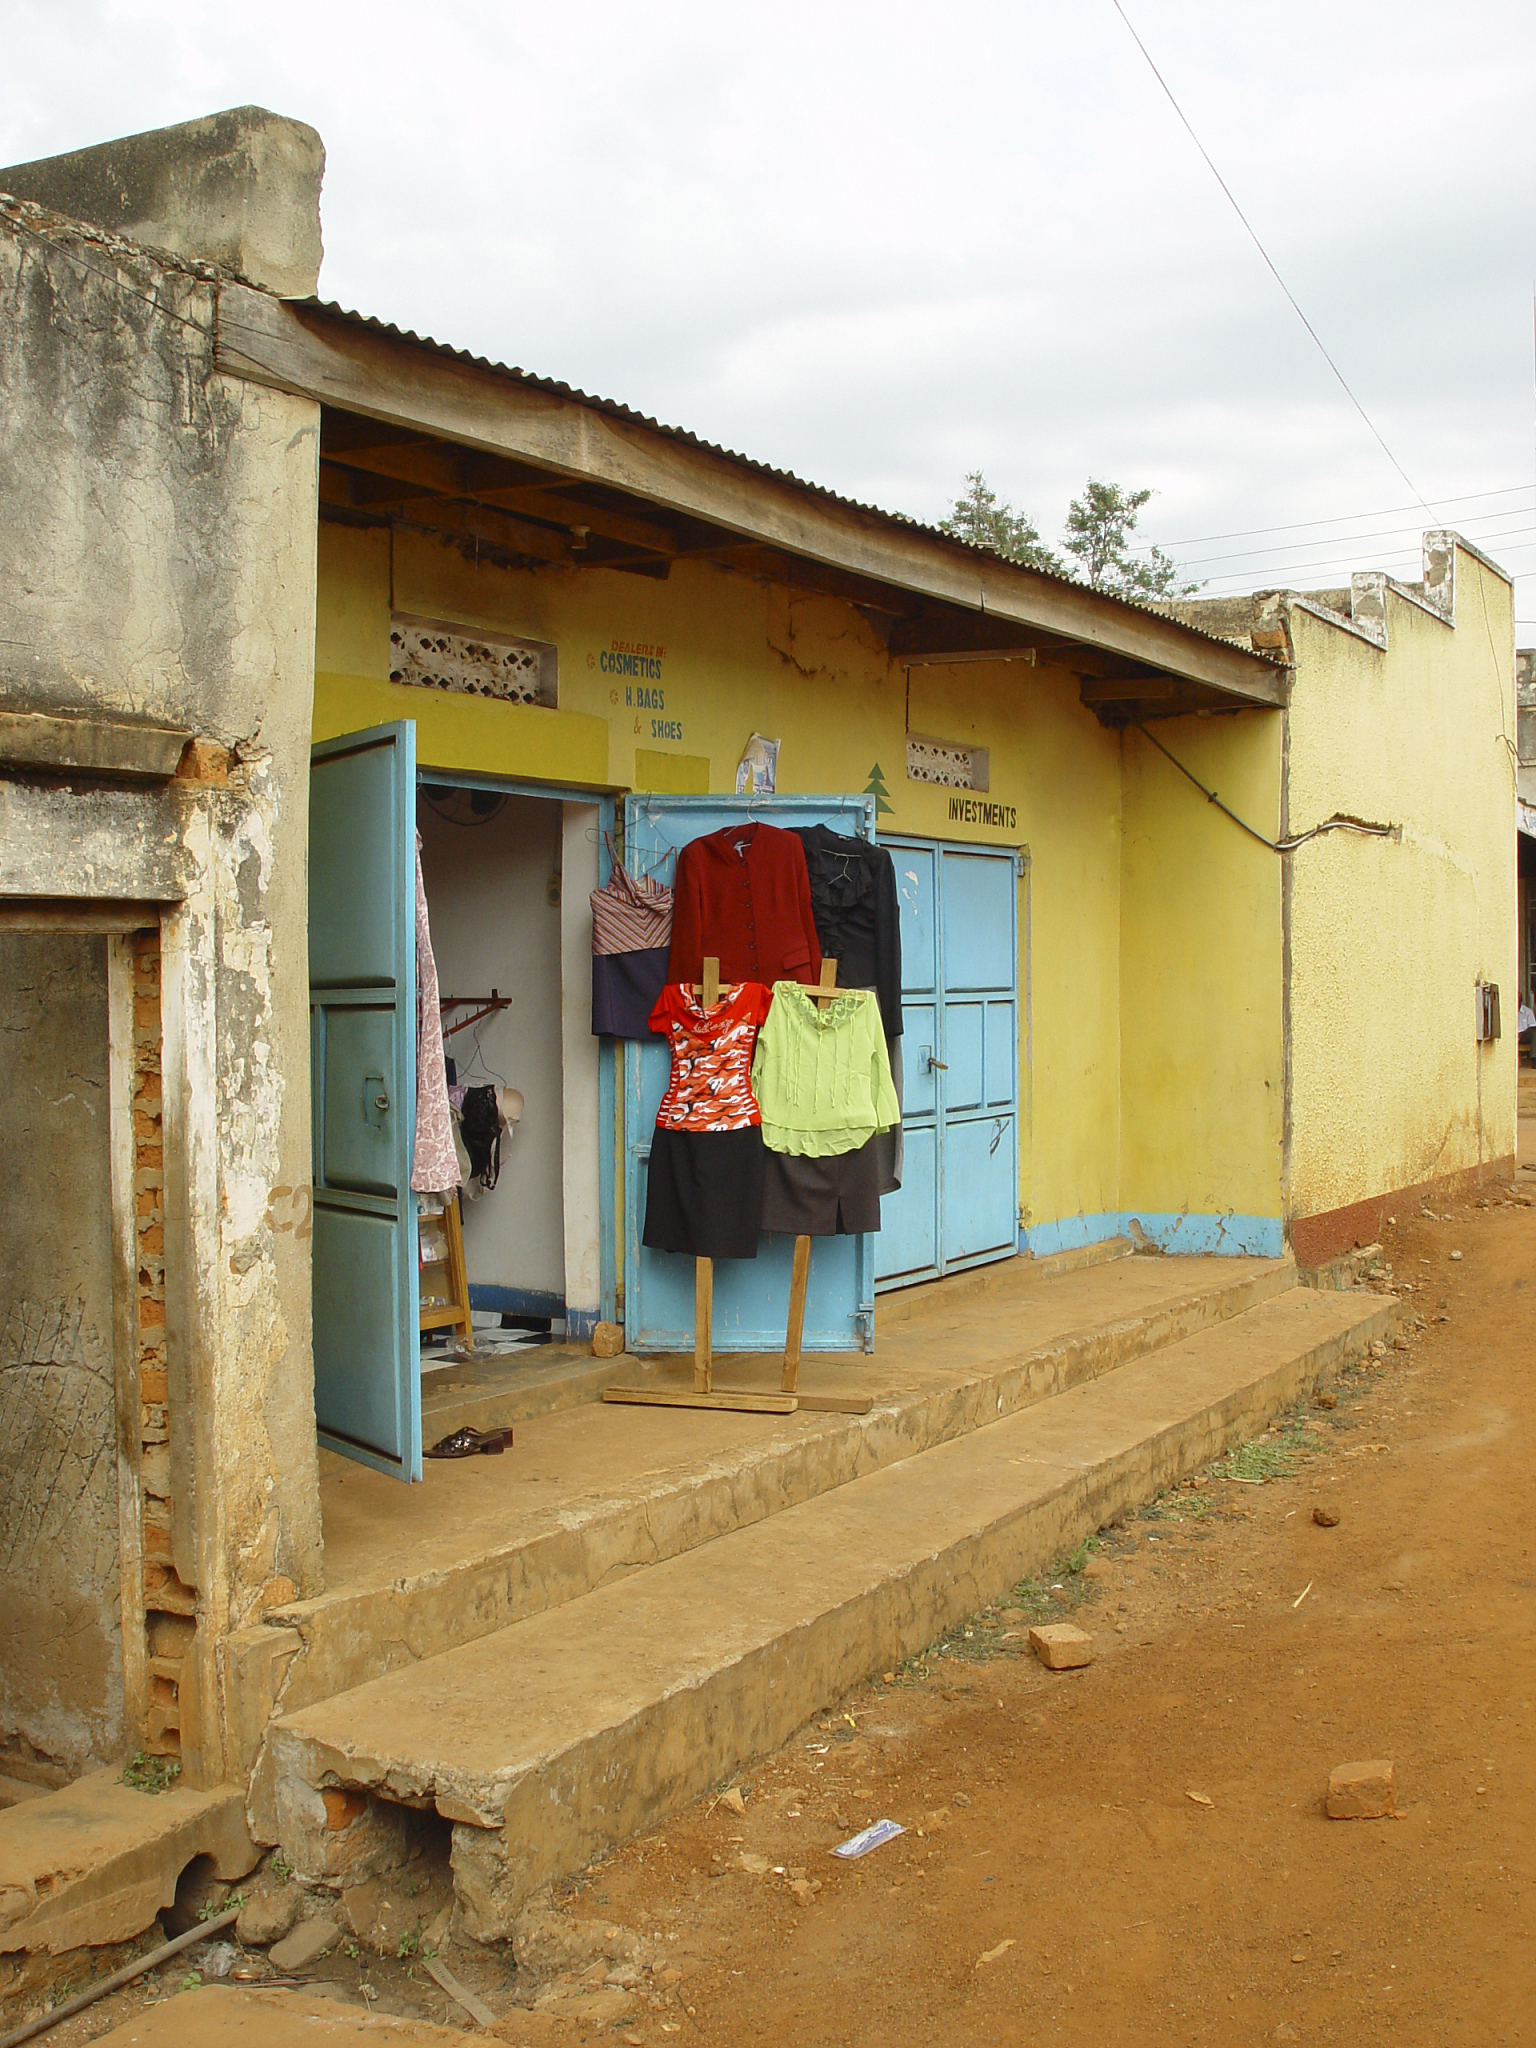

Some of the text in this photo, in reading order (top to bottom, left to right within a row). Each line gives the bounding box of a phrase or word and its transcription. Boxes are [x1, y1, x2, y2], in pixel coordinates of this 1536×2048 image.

[611, 640, 655, 657] DEALERS
[600, 650, 662, 680] COSMETICS
[651, 719, 683, 740] SHOES
[948, 797, 1017, 829] INVESTMENTS
